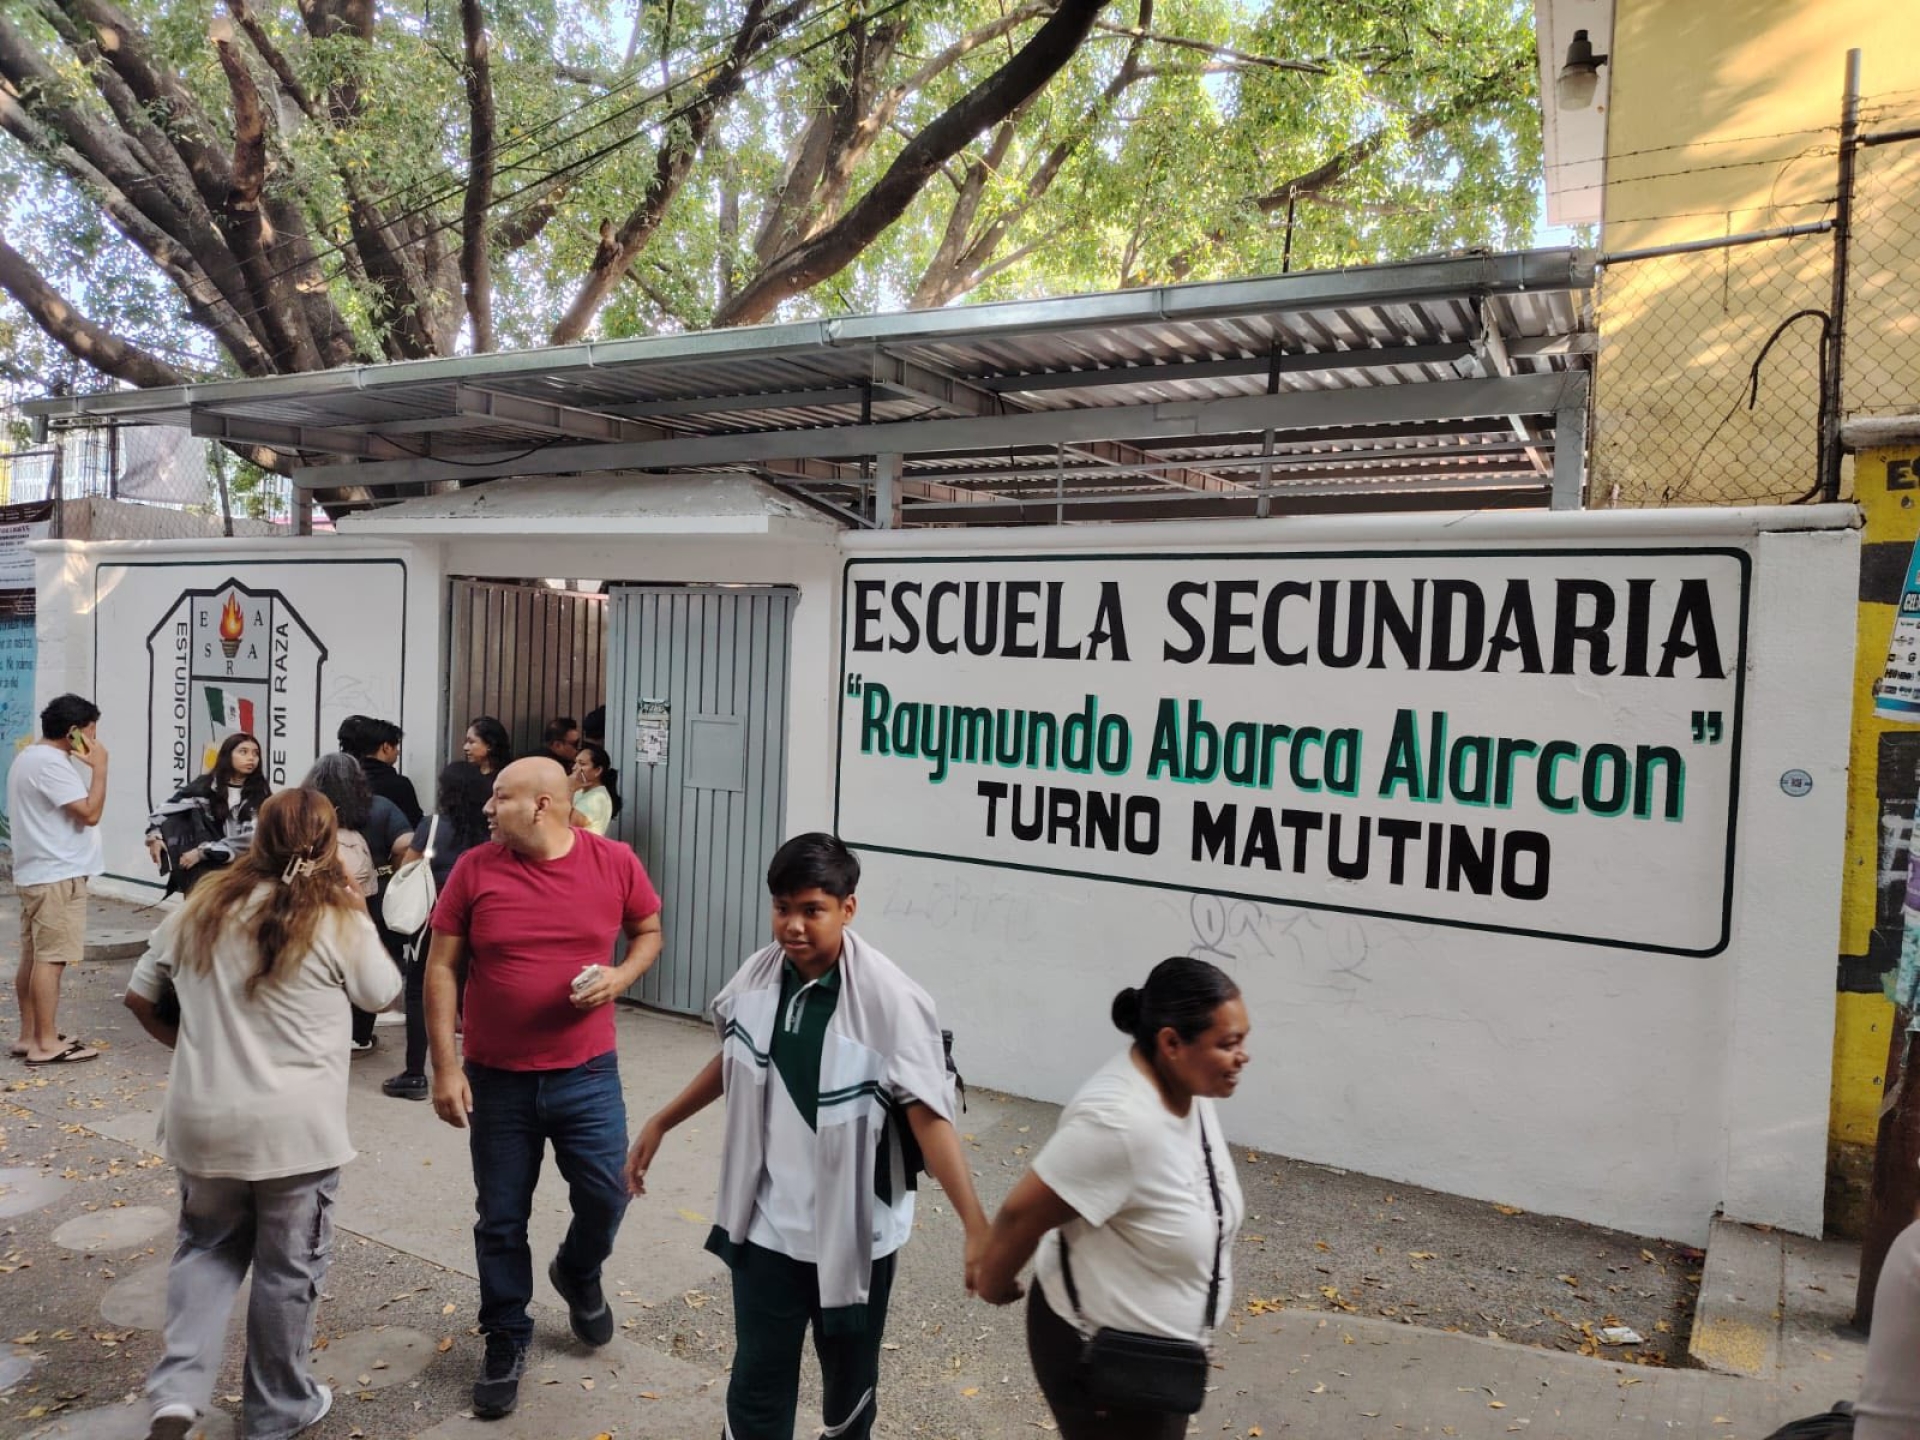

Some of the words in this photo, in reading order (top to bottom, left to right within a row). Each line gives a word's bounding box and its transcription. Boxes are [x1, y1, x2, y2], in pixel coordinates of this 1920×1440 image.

[200, 611, 208, 627] E
[254, 610, 264, 626] A
[853, 579, 1131, 661] ESCUELA
[1163, 578, 1727, 679] SECUNDARIA
[174, 622, 188, 720] ESTUDIO
[204, 643, 212, 658] S
[247, 643, 258, 659] A
[226, 660, 234, 675] R
[274, 623, 289, 693] RAZA
[274, 707, 287, 738] MI
[173, 725, 186, 770] POR
[273, 750, 286, 785] DE
[1146, 697, 1363, 798] Abarca
[977, 780, 1160, 856] TURNO
[1191, 800, 1550, 900] MATUTINO
